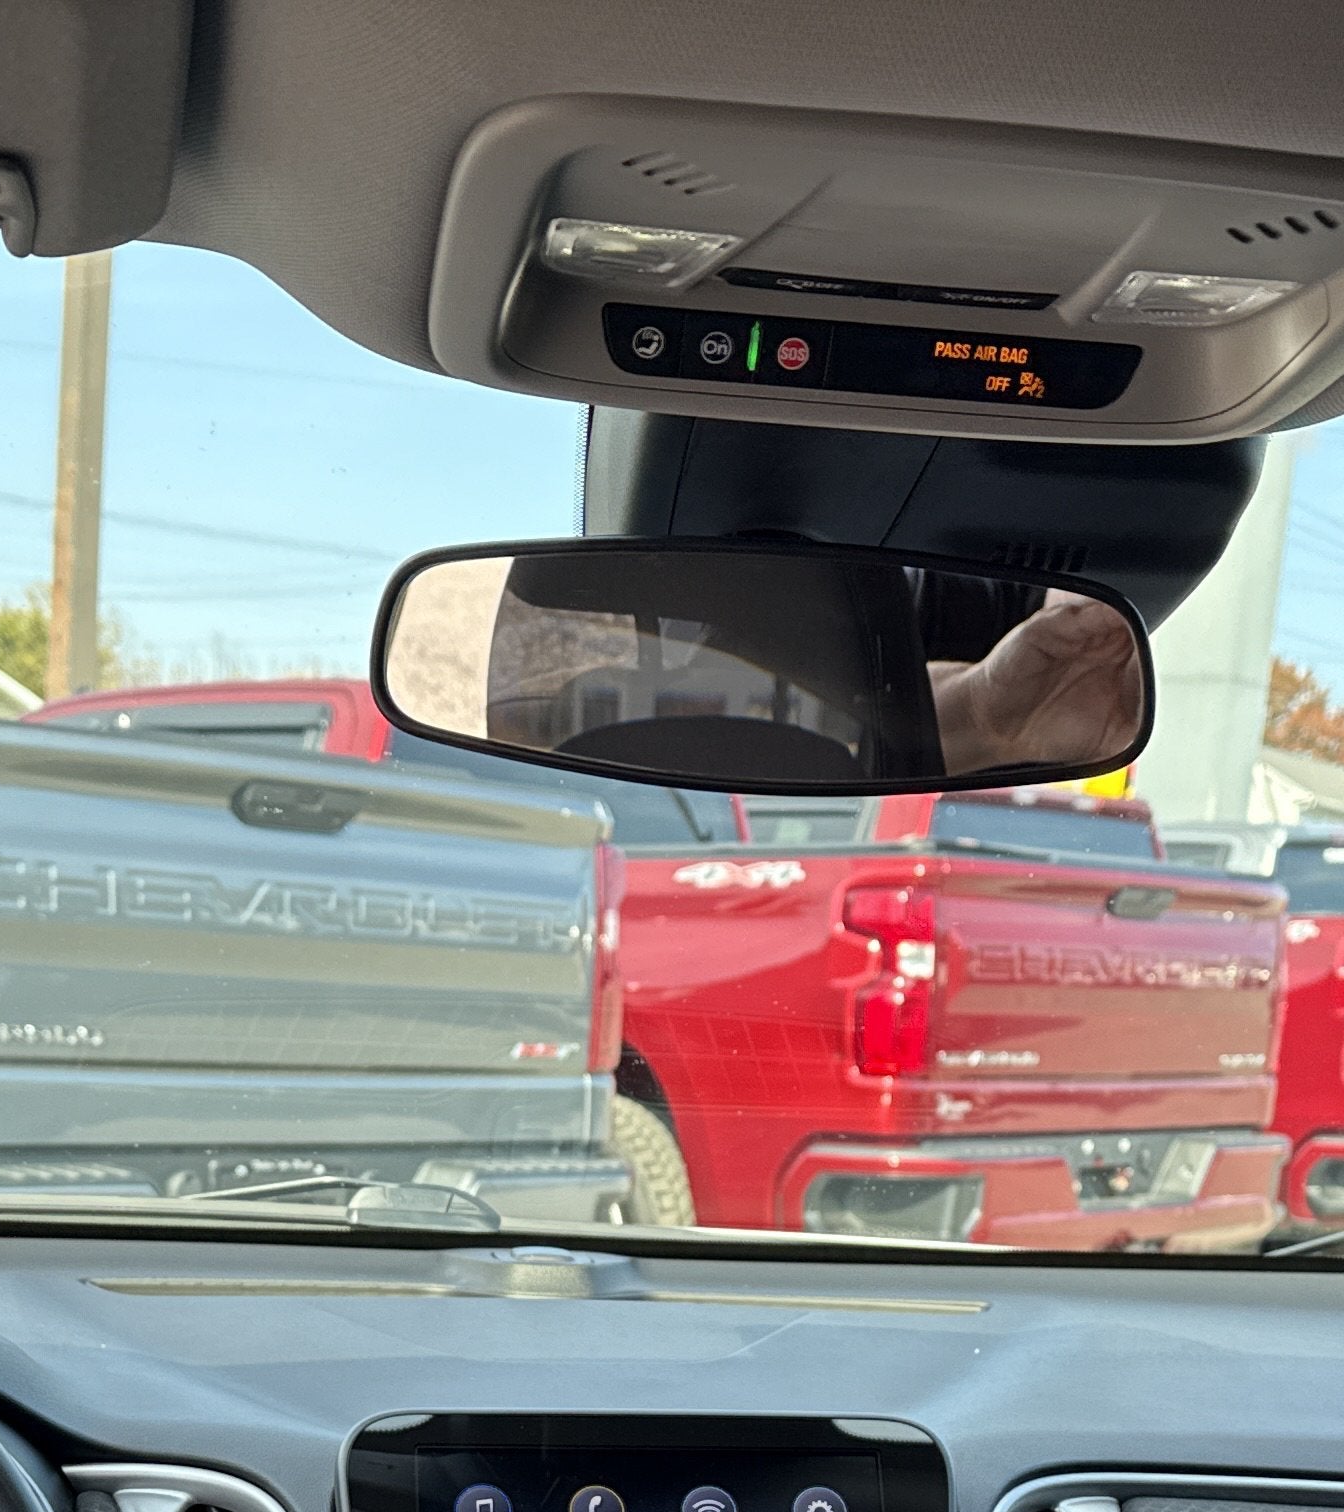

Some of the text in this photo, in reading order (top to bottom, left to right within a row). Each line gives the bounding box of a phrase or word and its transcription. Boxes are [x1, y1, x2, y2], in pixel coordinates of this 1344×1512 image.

[779, 346, 806, 362] SOS
[934, 341, 1029, 364] PASS AIR BAG
[985, 376, 1012, 392] OFF
